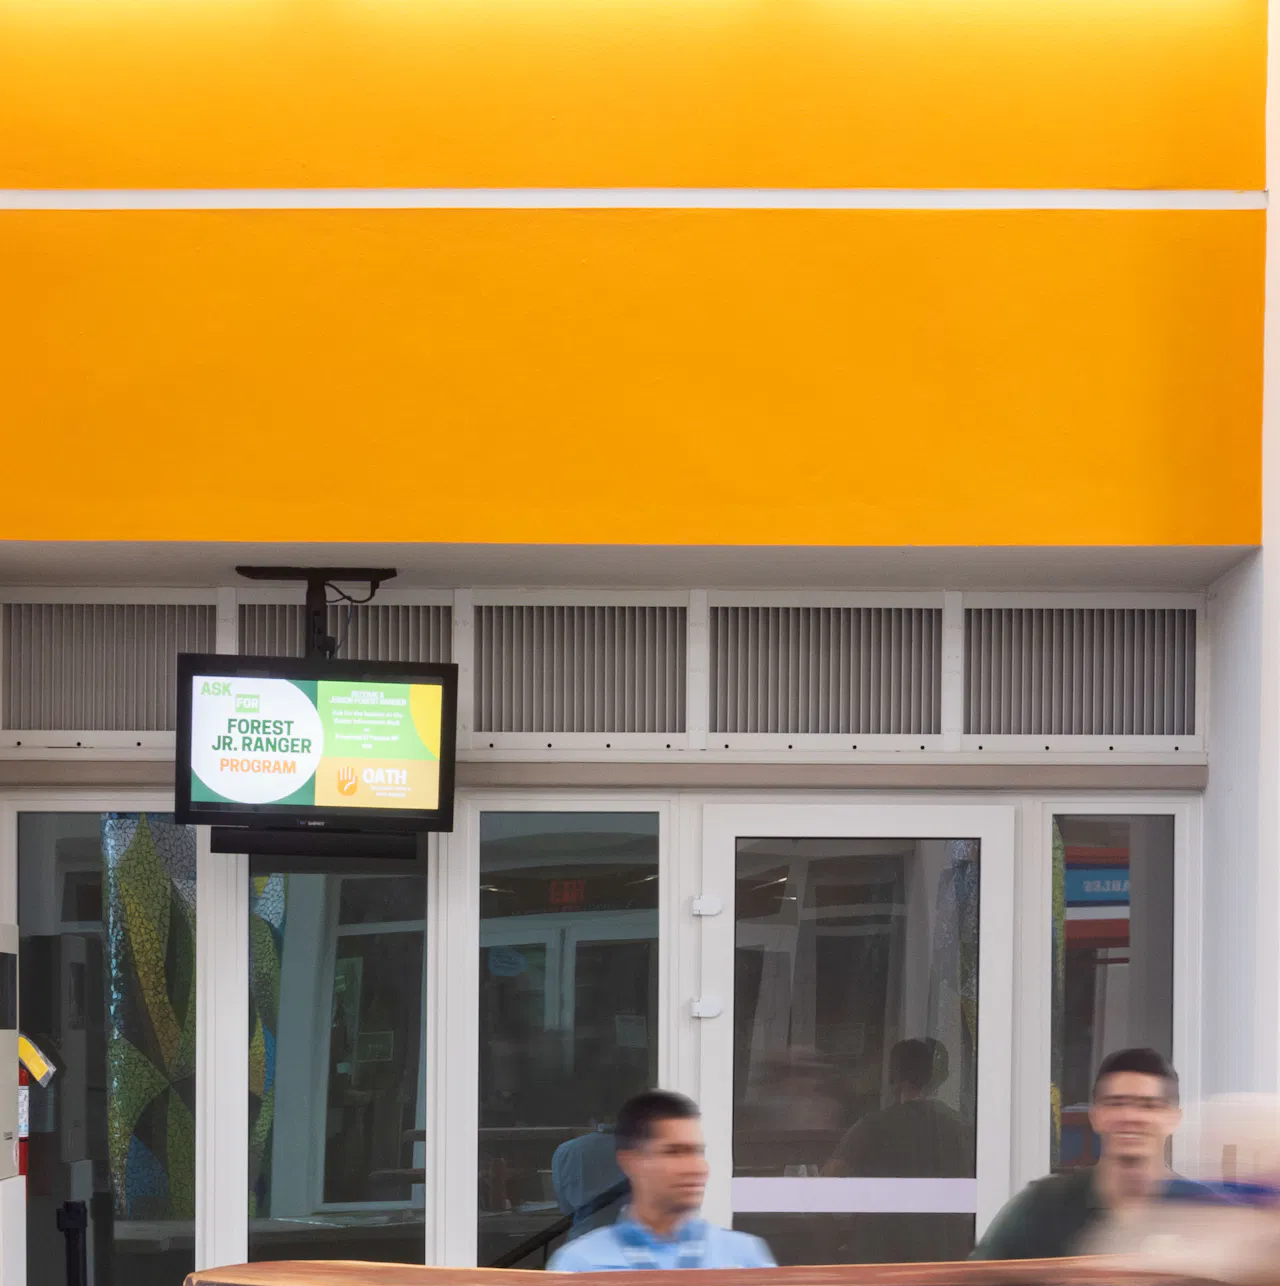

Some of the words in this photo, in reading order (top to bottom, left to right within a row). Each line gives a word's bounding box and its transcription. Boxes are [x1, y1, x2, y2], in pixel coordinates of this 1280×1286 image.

[200, 681, 233, 697] ASK
[236, 697, 259, 710] FOR
[227, 718, 295, 736] FOREST
[211, 735, 238, 751] JR.
[241, 736, 312, 754] RANGER
[220, 758, 297, 774] PROGRAM
[362, 768, 408, 785] OATH
